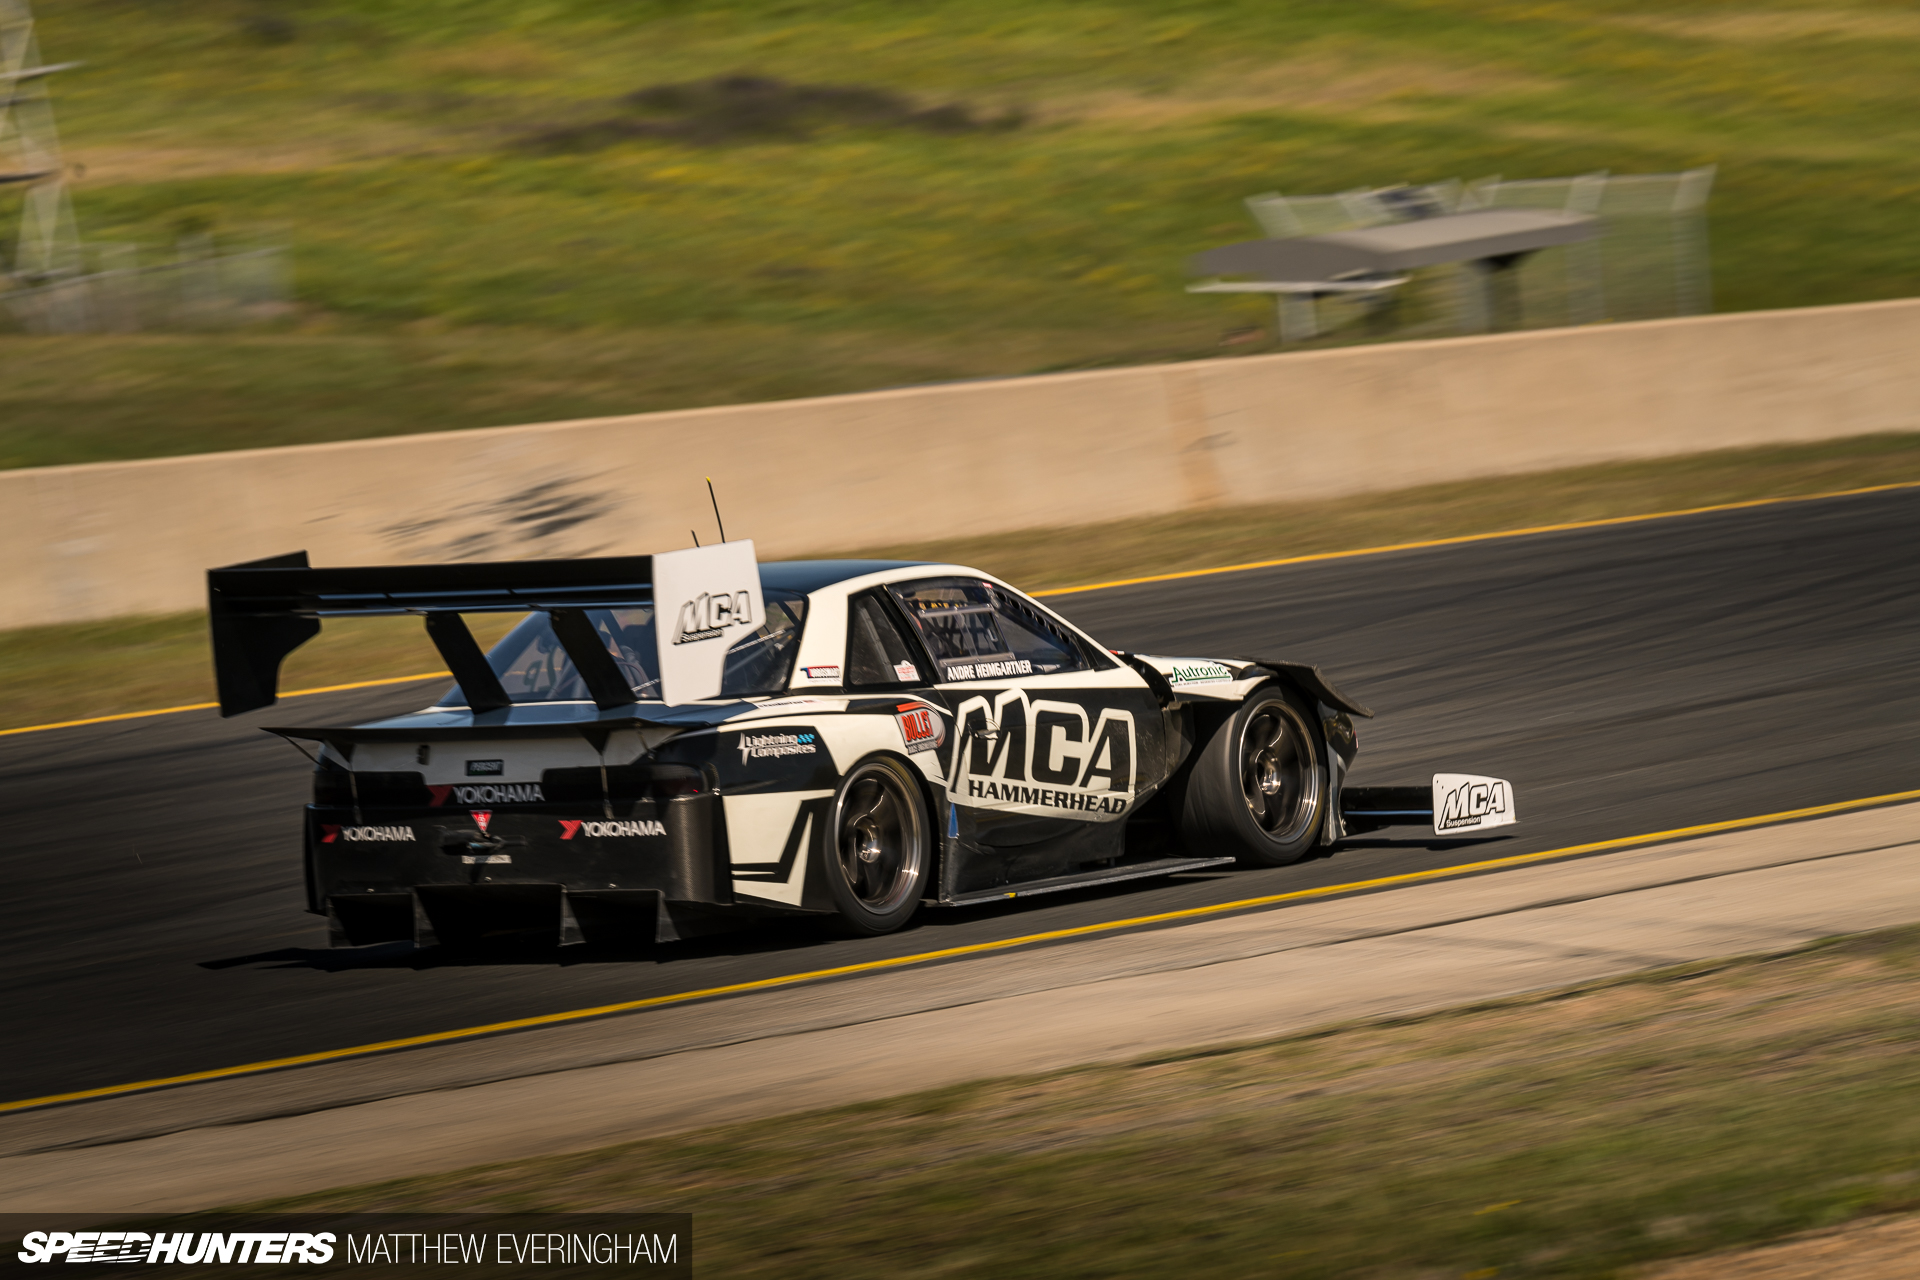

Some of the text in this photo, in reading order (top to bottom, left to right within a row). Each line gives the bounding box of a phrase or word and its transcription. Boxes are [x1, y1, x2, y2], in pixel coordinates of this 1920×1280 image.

[672, 589, 752, 645] MCA
[947, 660, 1033, 681] ANDRE HEIMGARTNER
[1171, 661, 1231, 683] Autronic
[901, 711, 934, 742] BULLET
[745, 733, 798, 747] Lightning
[949, 690, 1132, 794] MCA
[751, 744, 816, 758] Composites
[452, 784, 546, 804] YOKOHAMA
[968, 780, 1128, 814] HAMMERHEAD
[1438, 781, 1506, 830] MCA
[581, 820, 667, 837] YOKOHAMA
[1446, 815, 1481, 828] Suspension
[341, 826, 416, 841] YOKOHAMA
